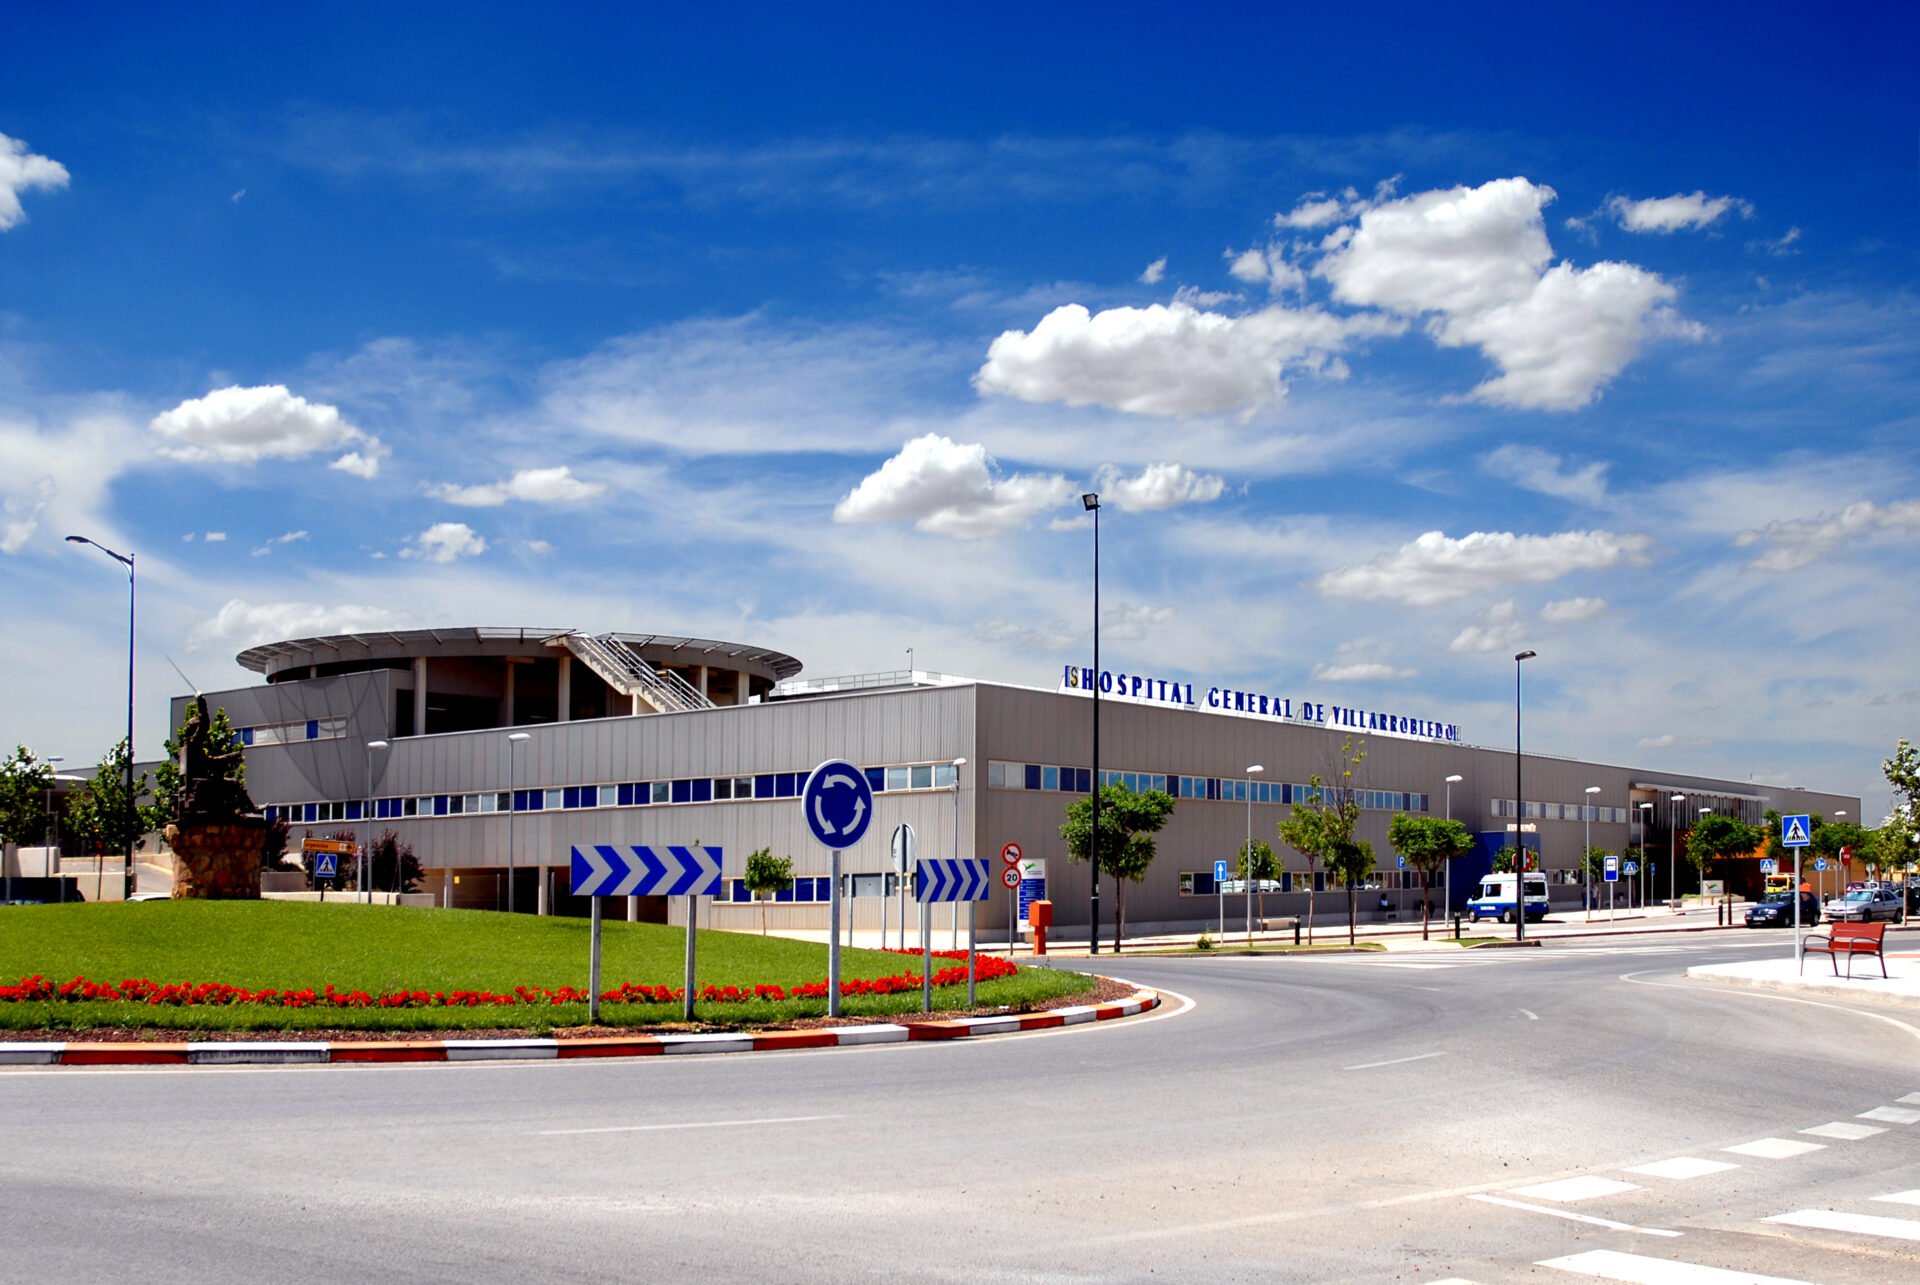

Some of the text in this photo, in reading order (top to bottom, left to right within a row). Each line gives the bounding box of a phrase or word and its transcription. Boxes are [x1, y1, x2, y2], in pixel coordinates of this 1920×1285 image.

[1081, 668, 1453, 741] HOSPITAL GENERAL DE VILLARROBLEDO
[1006, 873, 1018, 882] 20
